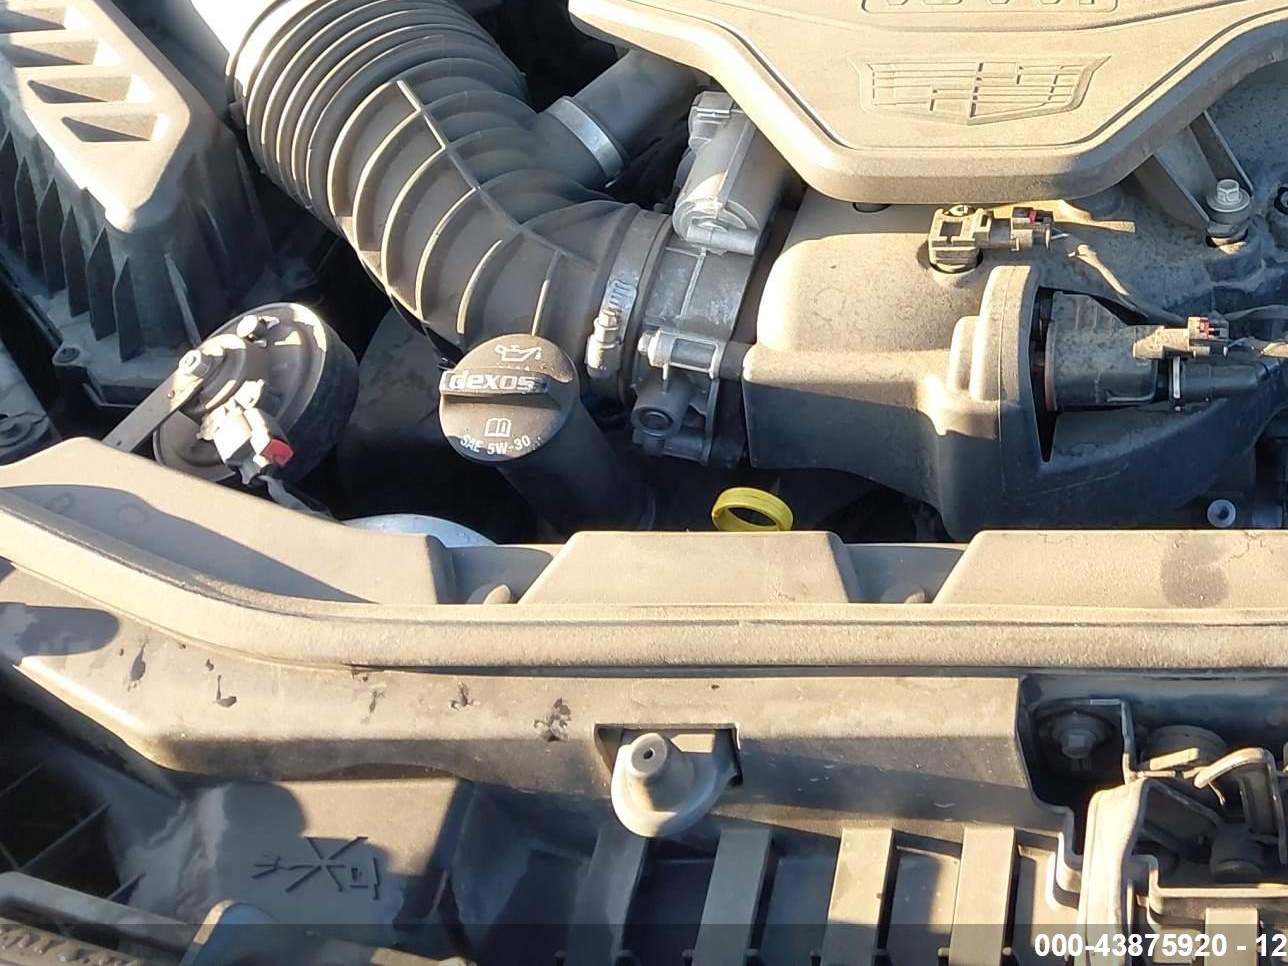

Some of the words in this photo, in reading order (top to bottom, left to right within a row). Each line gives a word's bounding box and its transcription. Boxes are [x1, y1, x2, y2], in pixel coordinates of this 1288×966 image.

[449, 369, 535, 390] dexos
[460, 434, 482, 452] SAE
[487, 436, 531, 454] 5W-30
